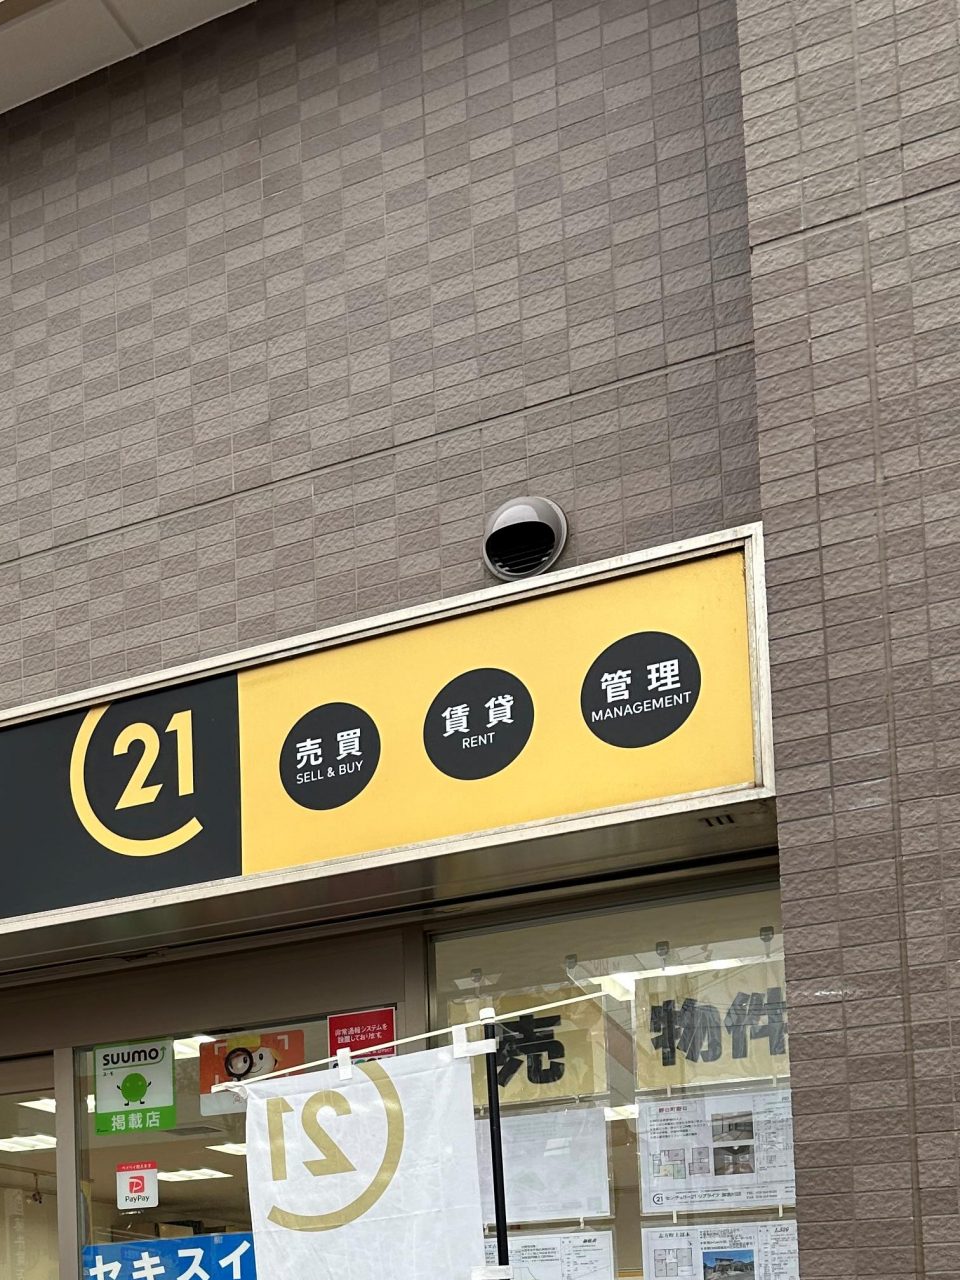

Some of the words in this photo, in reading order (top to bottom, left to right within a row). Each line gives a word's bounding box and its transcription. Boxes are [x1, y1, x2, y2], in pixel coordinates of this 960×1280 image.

[600, 658, 681, 703] 管理
[441, 694, 515, 736] 賃貸
[591, 690, 692, 723] MANAGEMENT
[295, 727, 363, 769] 売買
[462, 731, 496, 750] RENT
[296, 768, 325, 785] SELL
[327, 765, 336, 778] &
[338, 760, 364, 778] BUY
[650, 986, 788, 1067] 物件
[102, 1047, 159, 1067] SUUMO
[111, 1111, 161, 1131] 掲載店
[125, 1195, 150, 1204] PayPay
